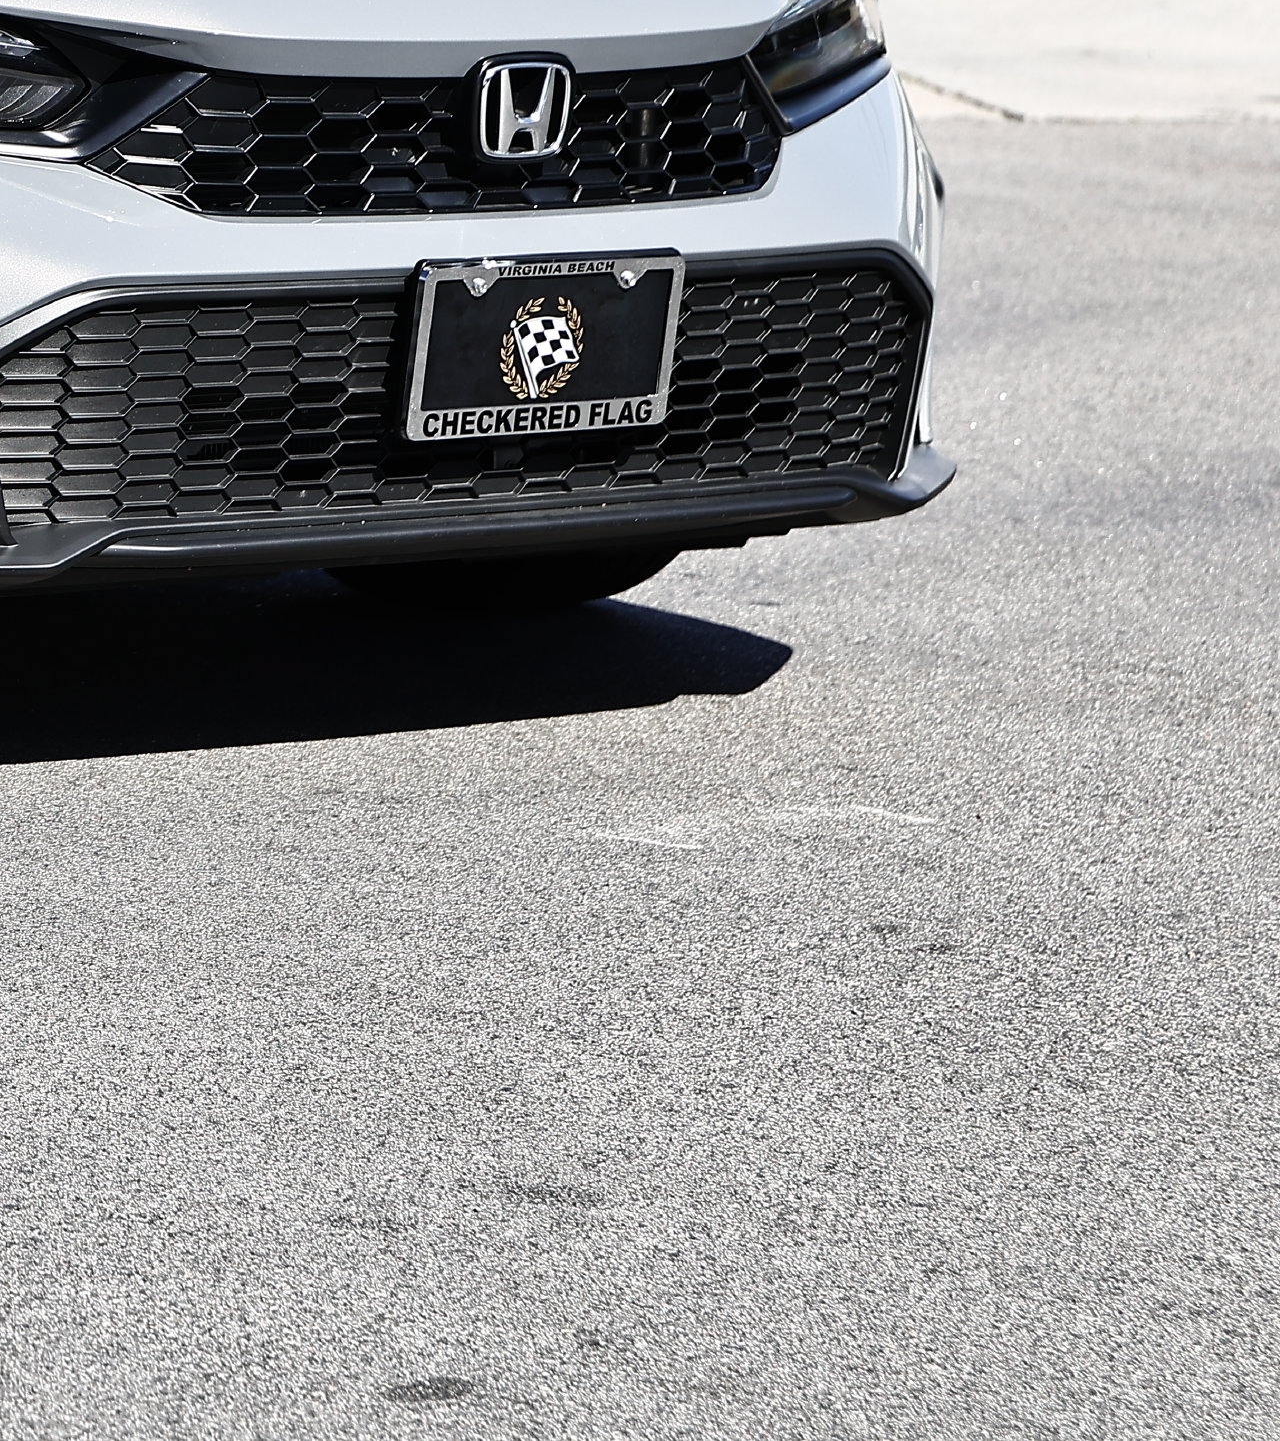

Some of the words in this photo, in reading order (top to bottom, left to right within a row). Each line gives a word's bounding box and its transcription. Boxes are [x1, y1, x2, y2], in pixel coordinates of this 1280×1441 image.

[498, 262, 562, 276] VIRGINIA
[567, 260, 616, 273] BEACH
[422, 405, 580, 437] CHECKERED
[587, 400, 653, 427] FLAG
